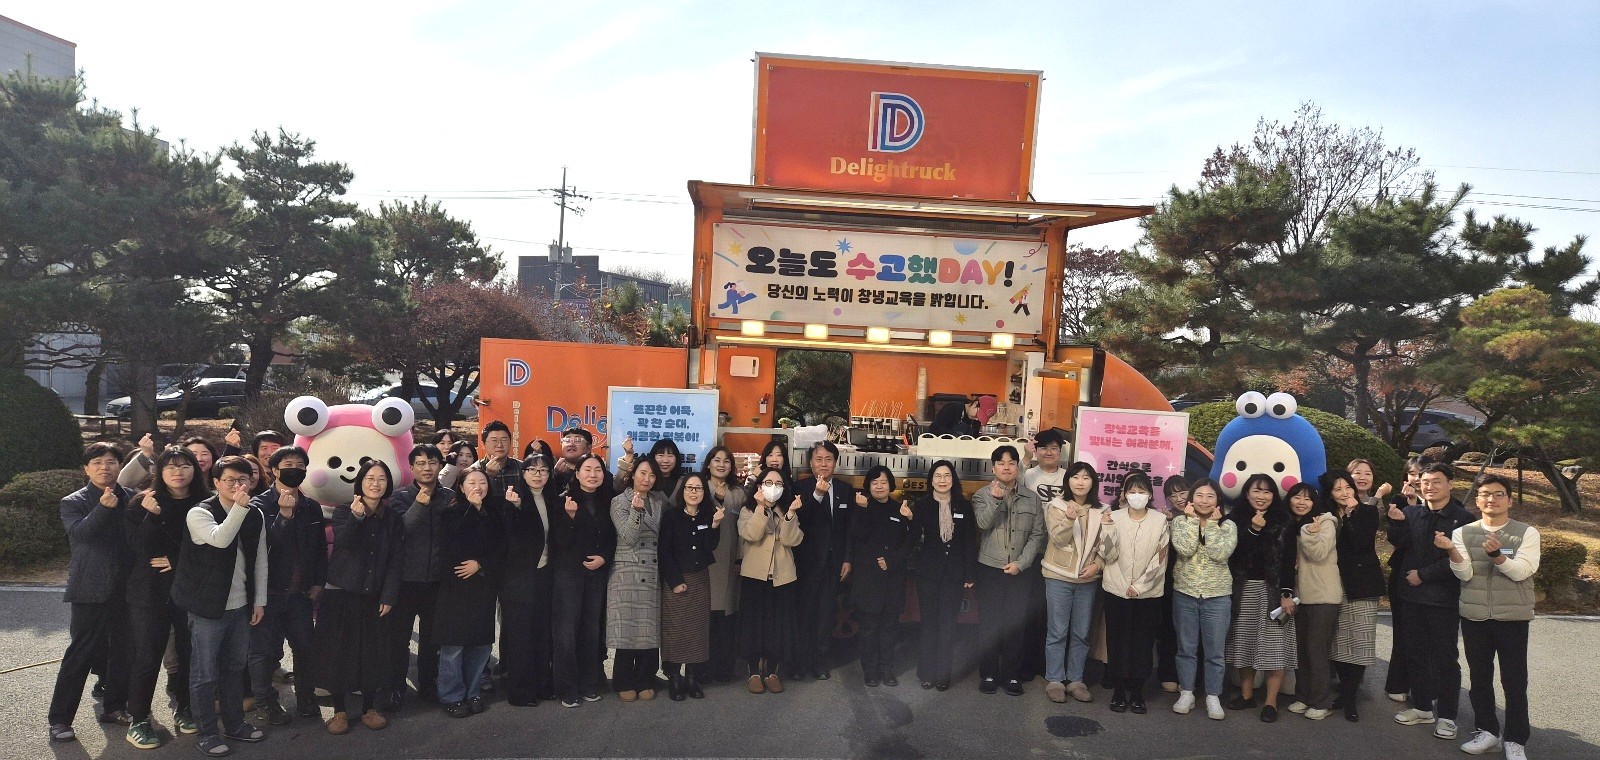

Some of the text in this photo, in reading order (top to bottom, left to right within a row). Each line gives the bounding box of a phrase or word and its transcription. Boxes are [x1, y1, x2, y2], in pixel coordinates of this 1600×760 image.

[830, 156, 956, 183] Delightruck
[745, 246, 1015, 287] 오늘도 수고했DAY!
[767, 283, 989, 310] 당신의 노력이 창녕교육을 밝힙니다.
[633, 404, 695, 417] 뜨끈한 어묵,
[650, 417, 663, 429] 찬
[664, 418, 690, 430] 순대,
[1104, 423, 1161, 437] 창녕교육을
[1089, 435, 1174, 451] 빛내는 여러분께,
[1106, 460, 1152, 473] 간식으로
